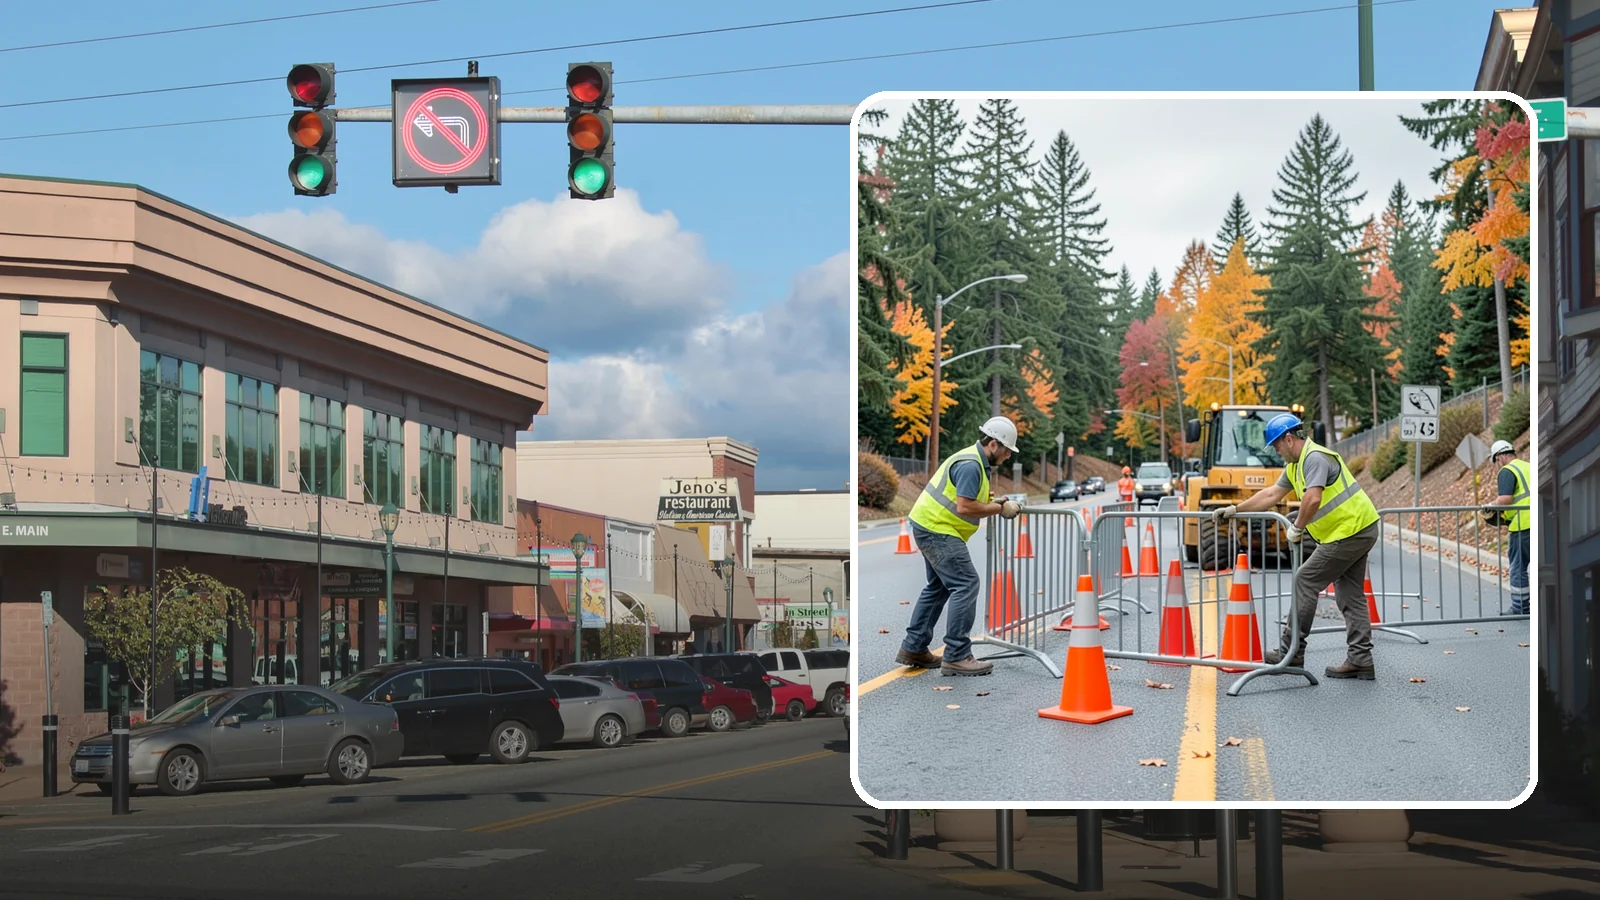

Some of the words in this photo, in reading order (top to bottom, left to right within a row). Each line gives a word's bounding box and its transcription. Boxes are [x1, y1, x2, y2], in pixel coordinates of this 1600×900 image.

[669, 480, 727, 494] Jeno's
[665, 496, 731, 509] restaurant
[659, 509, 682, 520] Italian
[686, 509, 714, 519] American
[715, 509, 737, 519] Cuisine
[2, 525, 13, 536] E.
[15, 525, 49, 536] MAIN
[797, 607, 828, 617] Street
